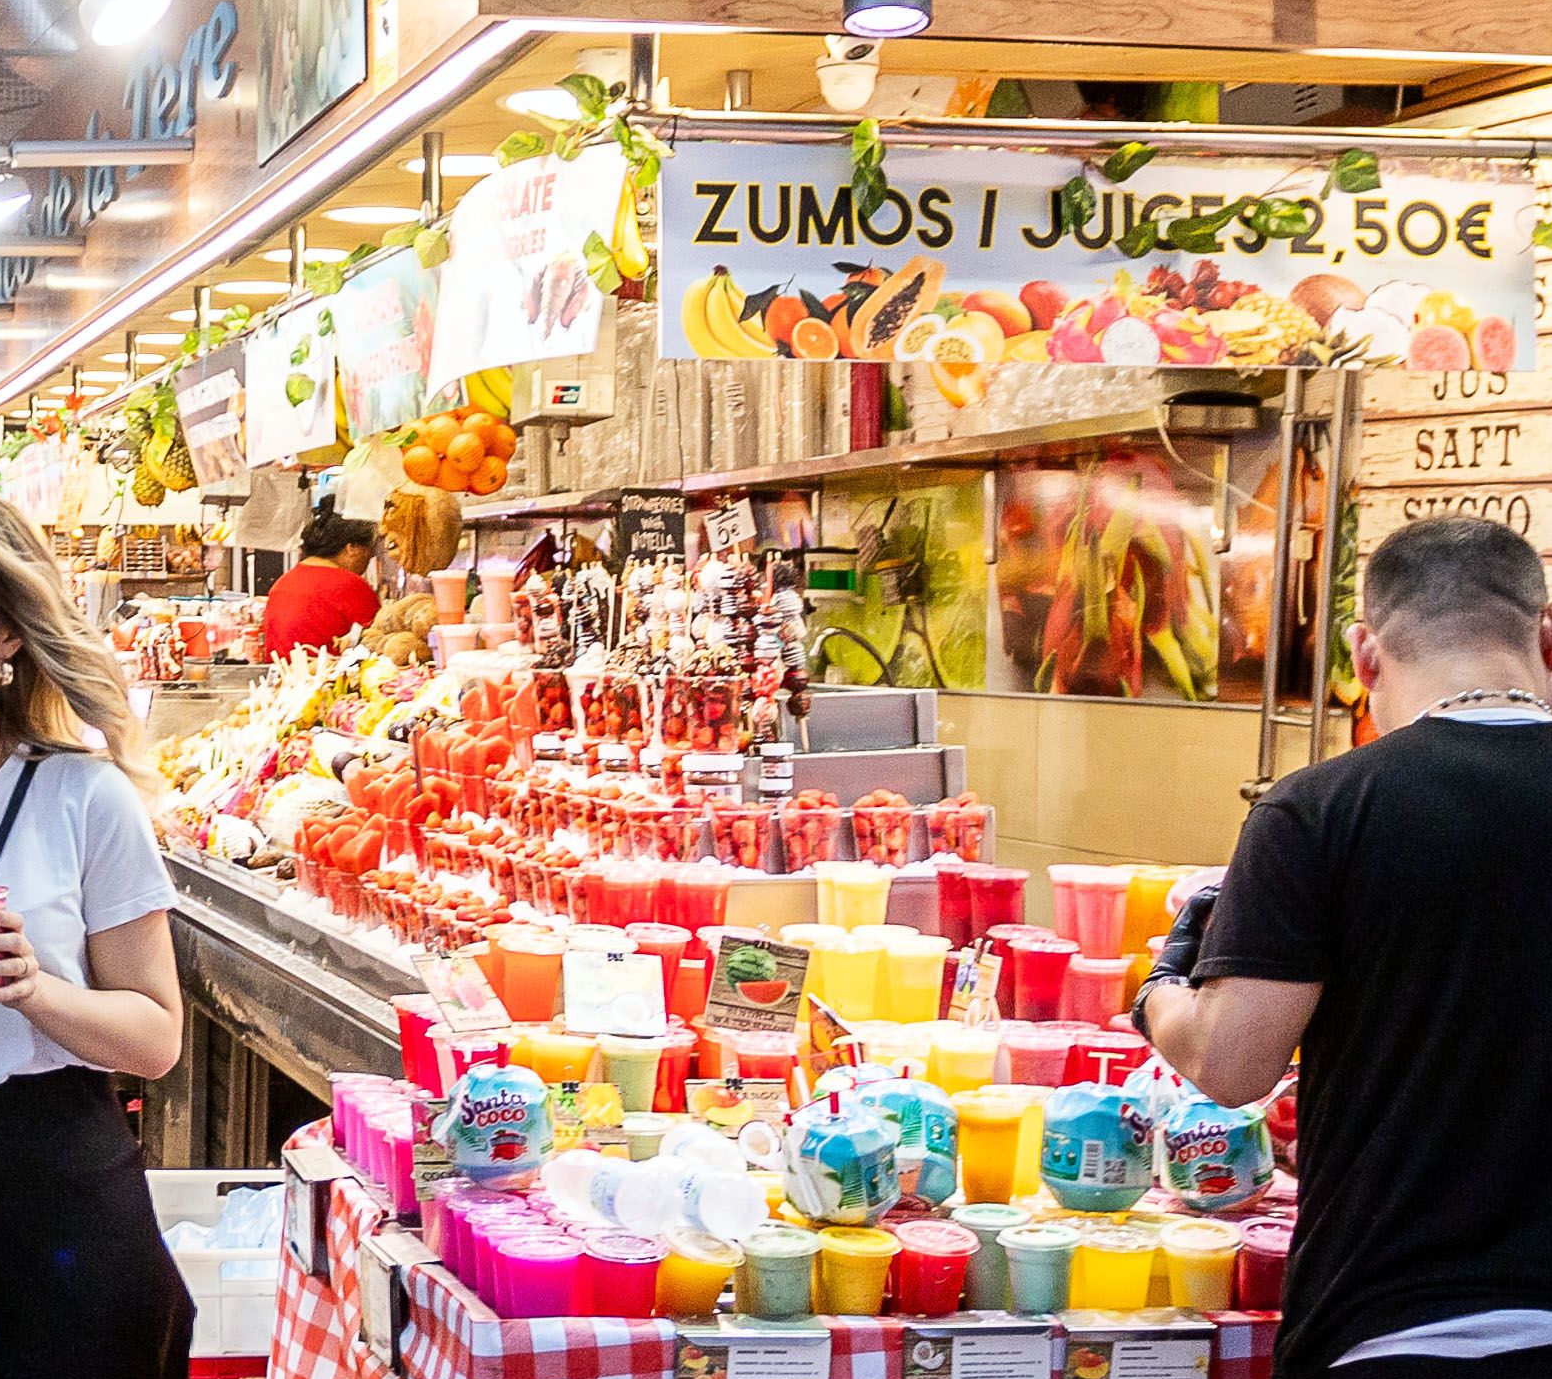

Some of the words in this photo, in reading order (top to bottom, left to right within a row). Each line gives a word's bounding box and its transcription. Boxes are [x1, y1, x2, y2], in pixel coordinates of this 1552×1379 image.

[692, 181, 954, 250] ZUMOS
[1288, 195, 1495, 266] 2,50€
[1414, 423, 1521, 471] SAFT
[460, 1088, 528, 1126] Santa
[475, 1107, 528, 1129] coco
[1176, 1138, 1229, 1165] coco
